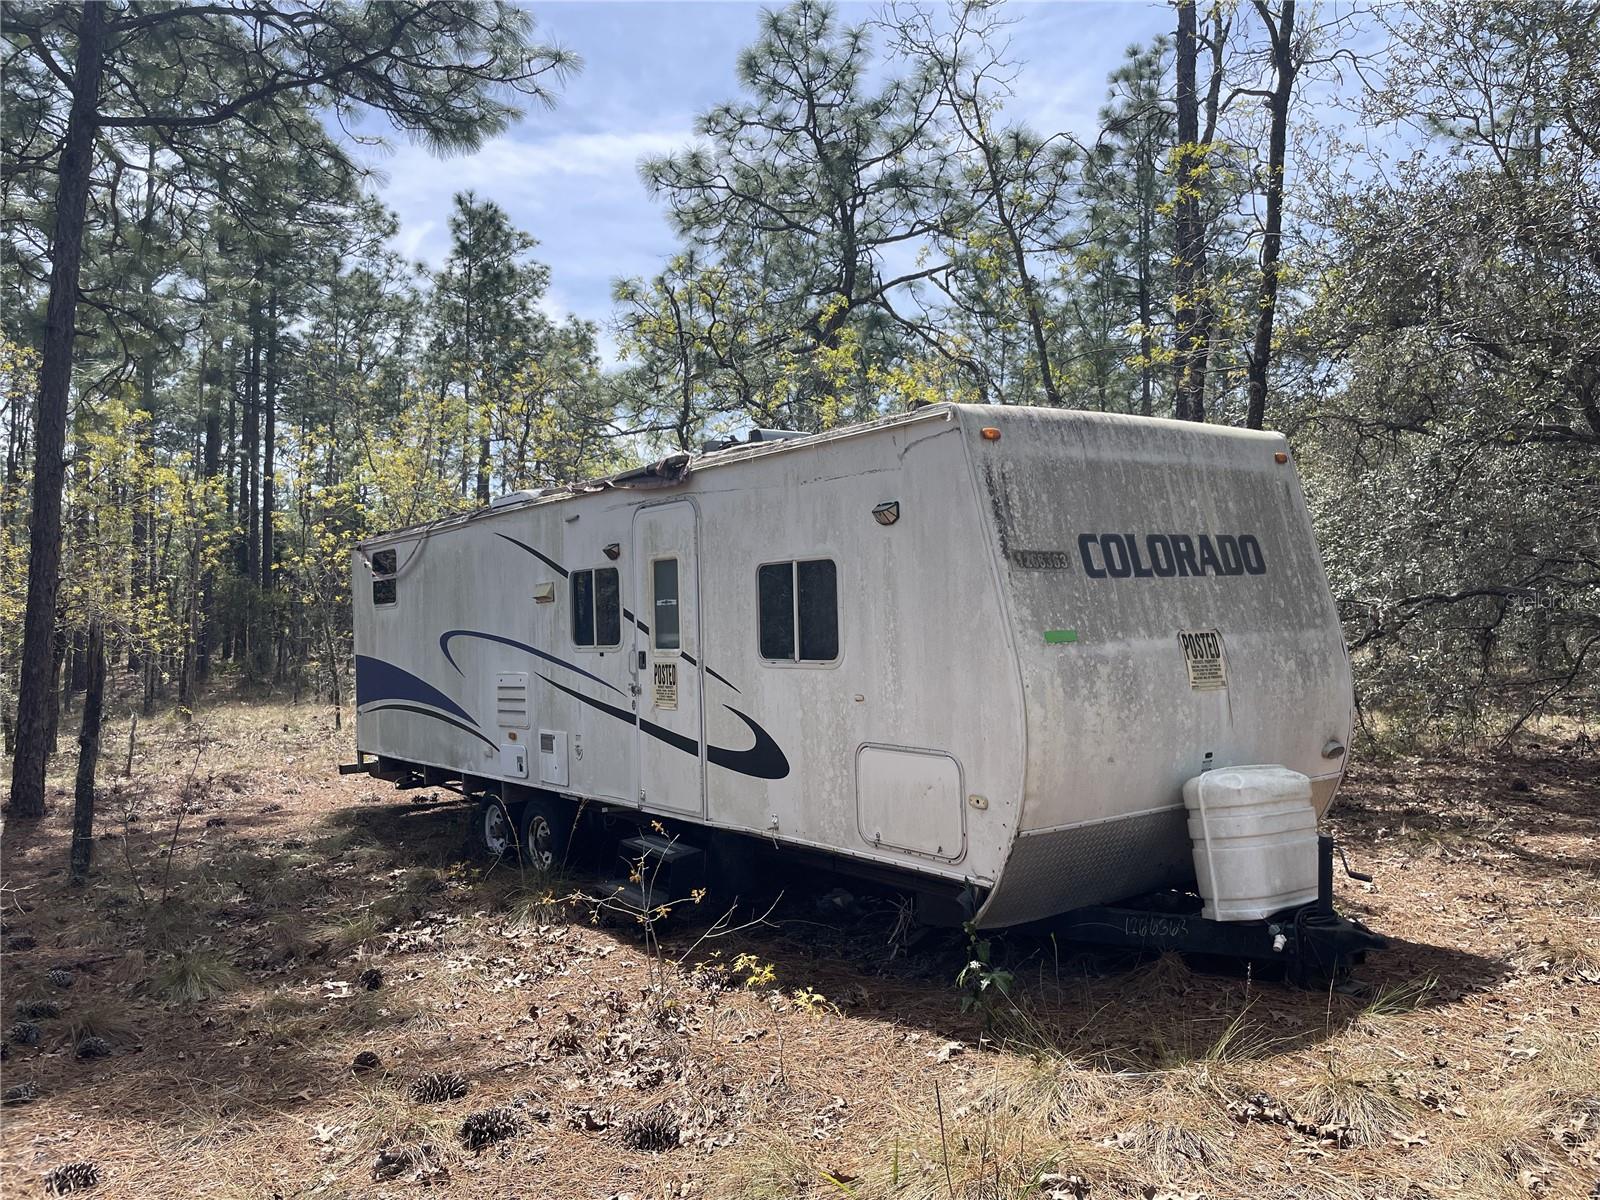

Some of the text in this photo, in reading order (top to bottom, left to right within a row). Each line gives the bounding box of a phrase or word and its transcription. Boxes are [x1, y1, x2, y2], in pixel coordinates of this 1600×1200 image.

[1078, 533, 1266, 578] COLORADO
[1181, 632, 1221, 660] POSTED
[654, 663, 676, 686] POSTED
